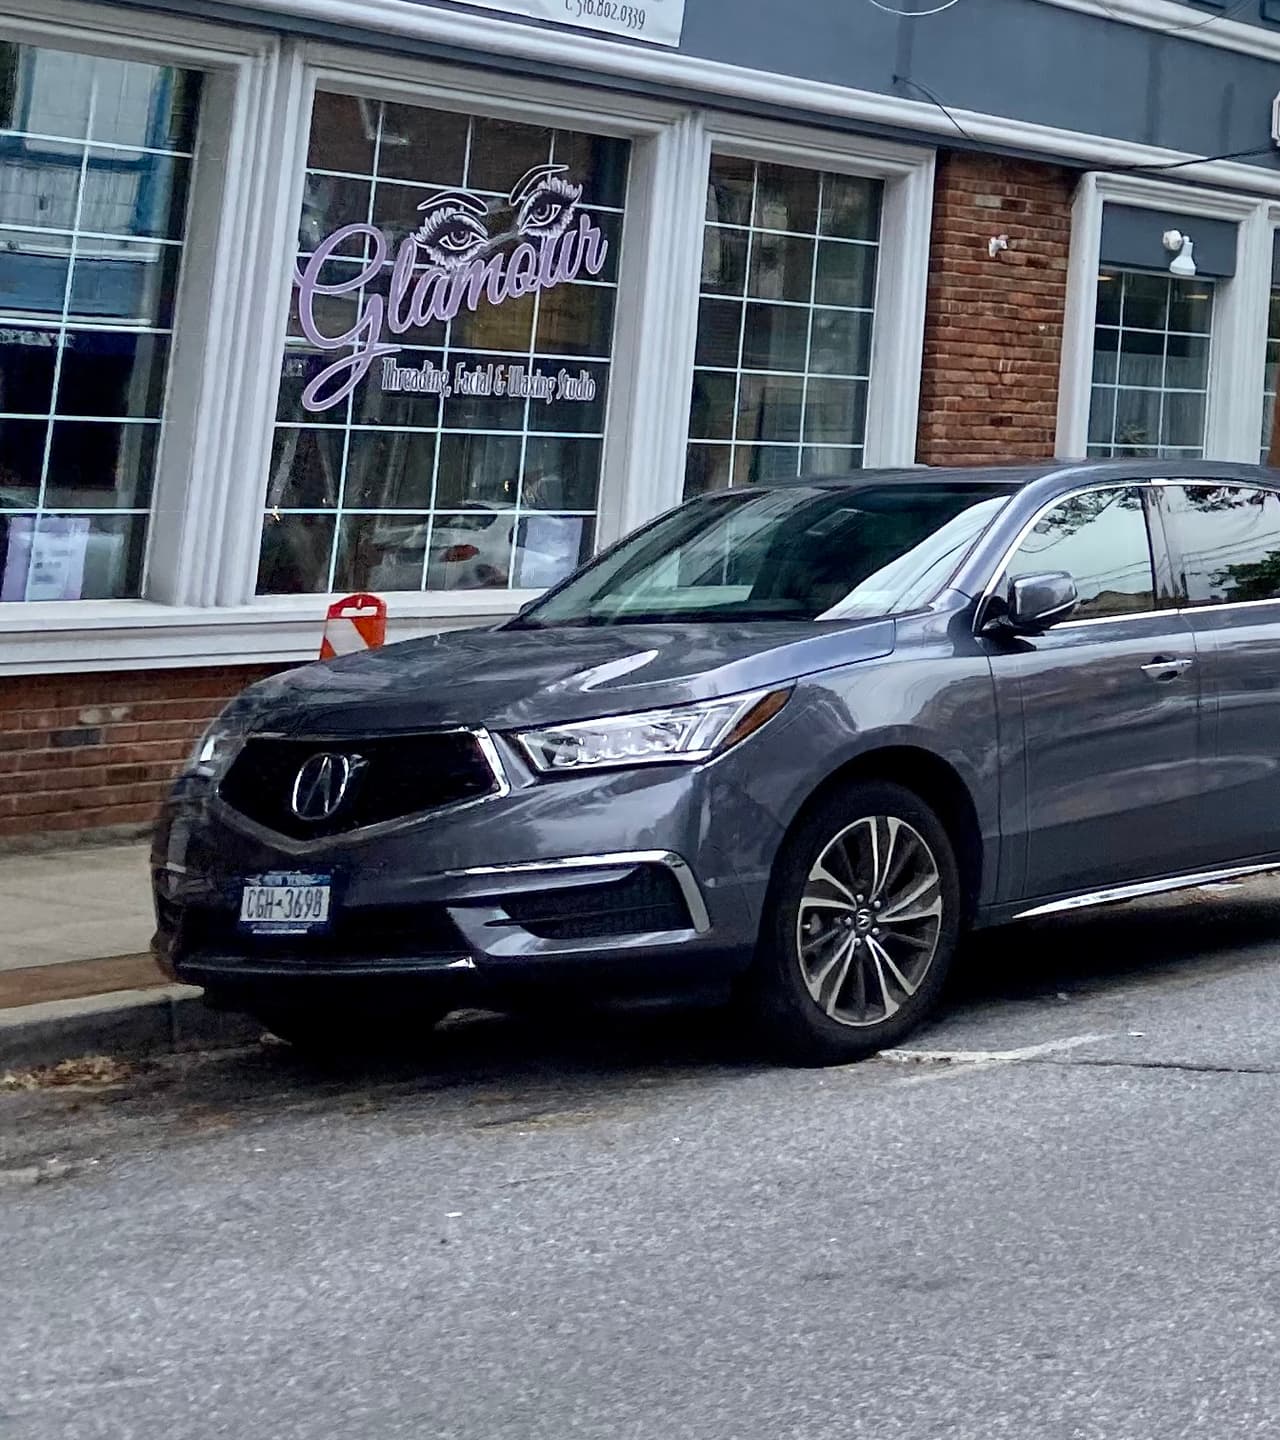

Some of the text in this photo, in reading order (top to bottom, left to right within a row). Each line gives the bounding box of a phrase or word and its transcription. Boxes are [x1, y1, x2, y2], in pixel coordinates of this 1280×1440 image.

[294, 214, 608, 412] Glamour
[454, 362, 492, 396] Facial
[508, 365, 554, 404] Waxing
[556, 368, 597, 402] Studio
